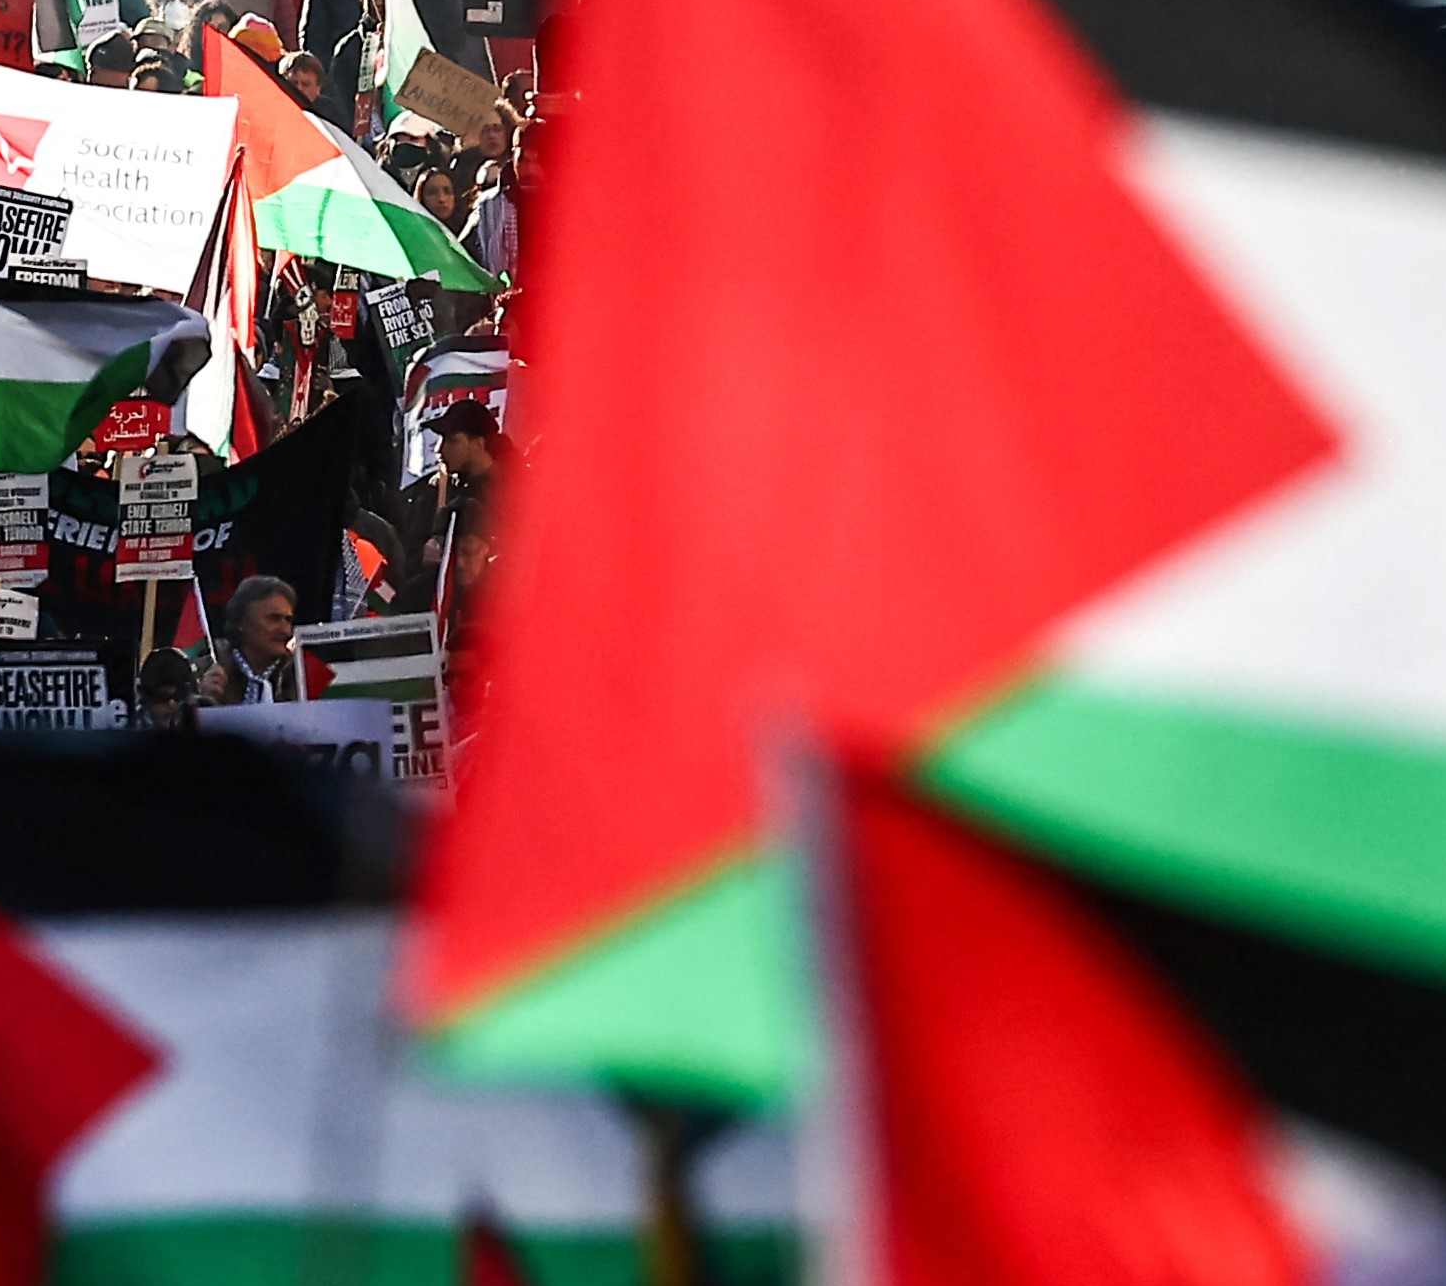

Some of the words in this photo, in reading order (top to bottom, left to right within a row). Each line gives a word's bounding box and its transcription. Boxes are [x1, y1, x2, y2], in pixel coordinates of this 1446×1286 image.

[62, 164, 149, 192] Health
[388, 328, 411, 347] THE
[49, 511, 117, 553] FRIE
[193, 520, 233, 552] OF
[121, 520, 152, 535] STATE
